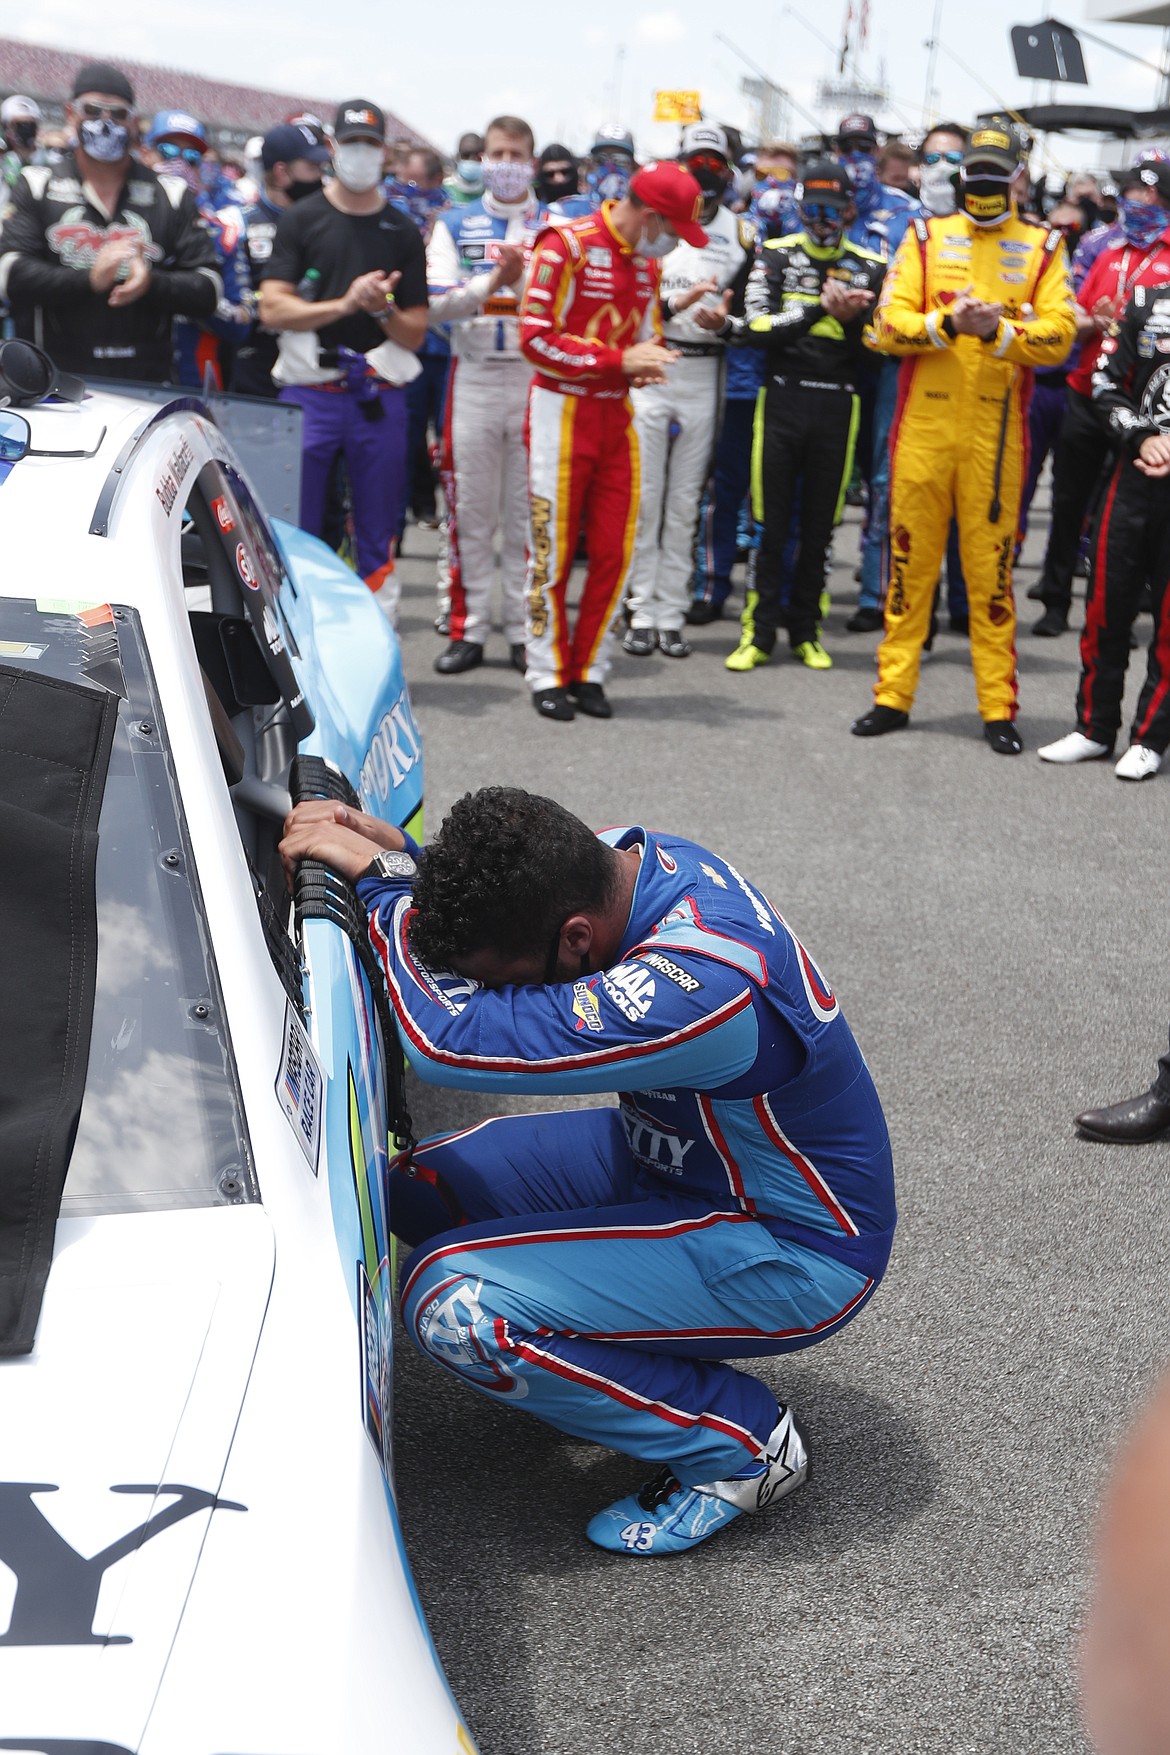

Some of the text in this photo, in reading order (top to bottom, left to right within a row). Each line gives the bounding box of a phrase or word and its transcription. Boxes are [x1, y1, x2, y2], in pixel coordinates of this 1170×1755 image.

[606, 963, 656, 1015] MAC
[645, 953, 700, 992] NASCAR
[573, 982, 604, 1032] SUNOCO
[301, 1058, 316, 1143] RACE CAR
[620, 1521, 657, 1550] 43
